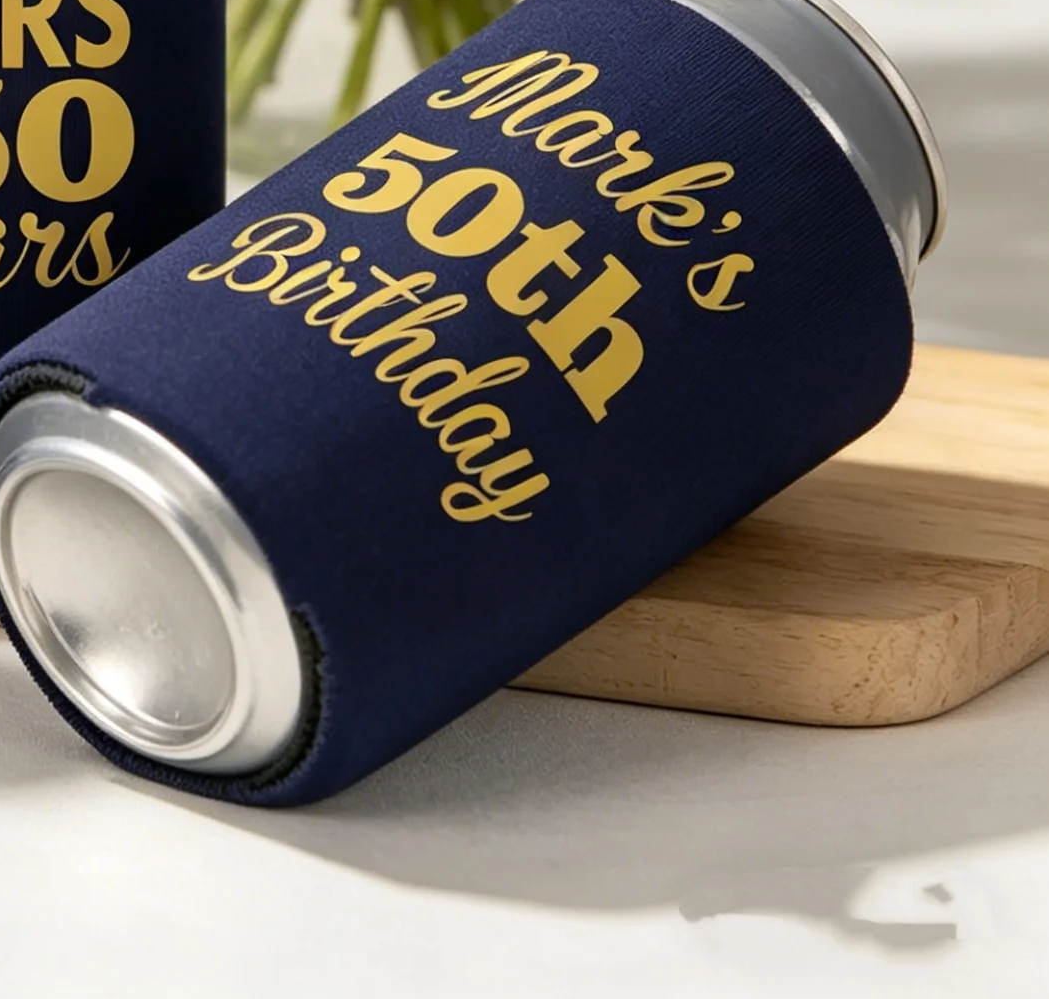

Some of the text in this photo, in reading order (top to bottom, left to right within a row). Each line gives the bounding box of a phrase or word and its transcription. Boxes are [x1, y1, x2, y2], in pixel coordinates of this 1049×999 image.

[322, 132, 645, 423] 50th
[426, 49, 756, 311] Mark's
[187, 212, 551, 523] Birthday
